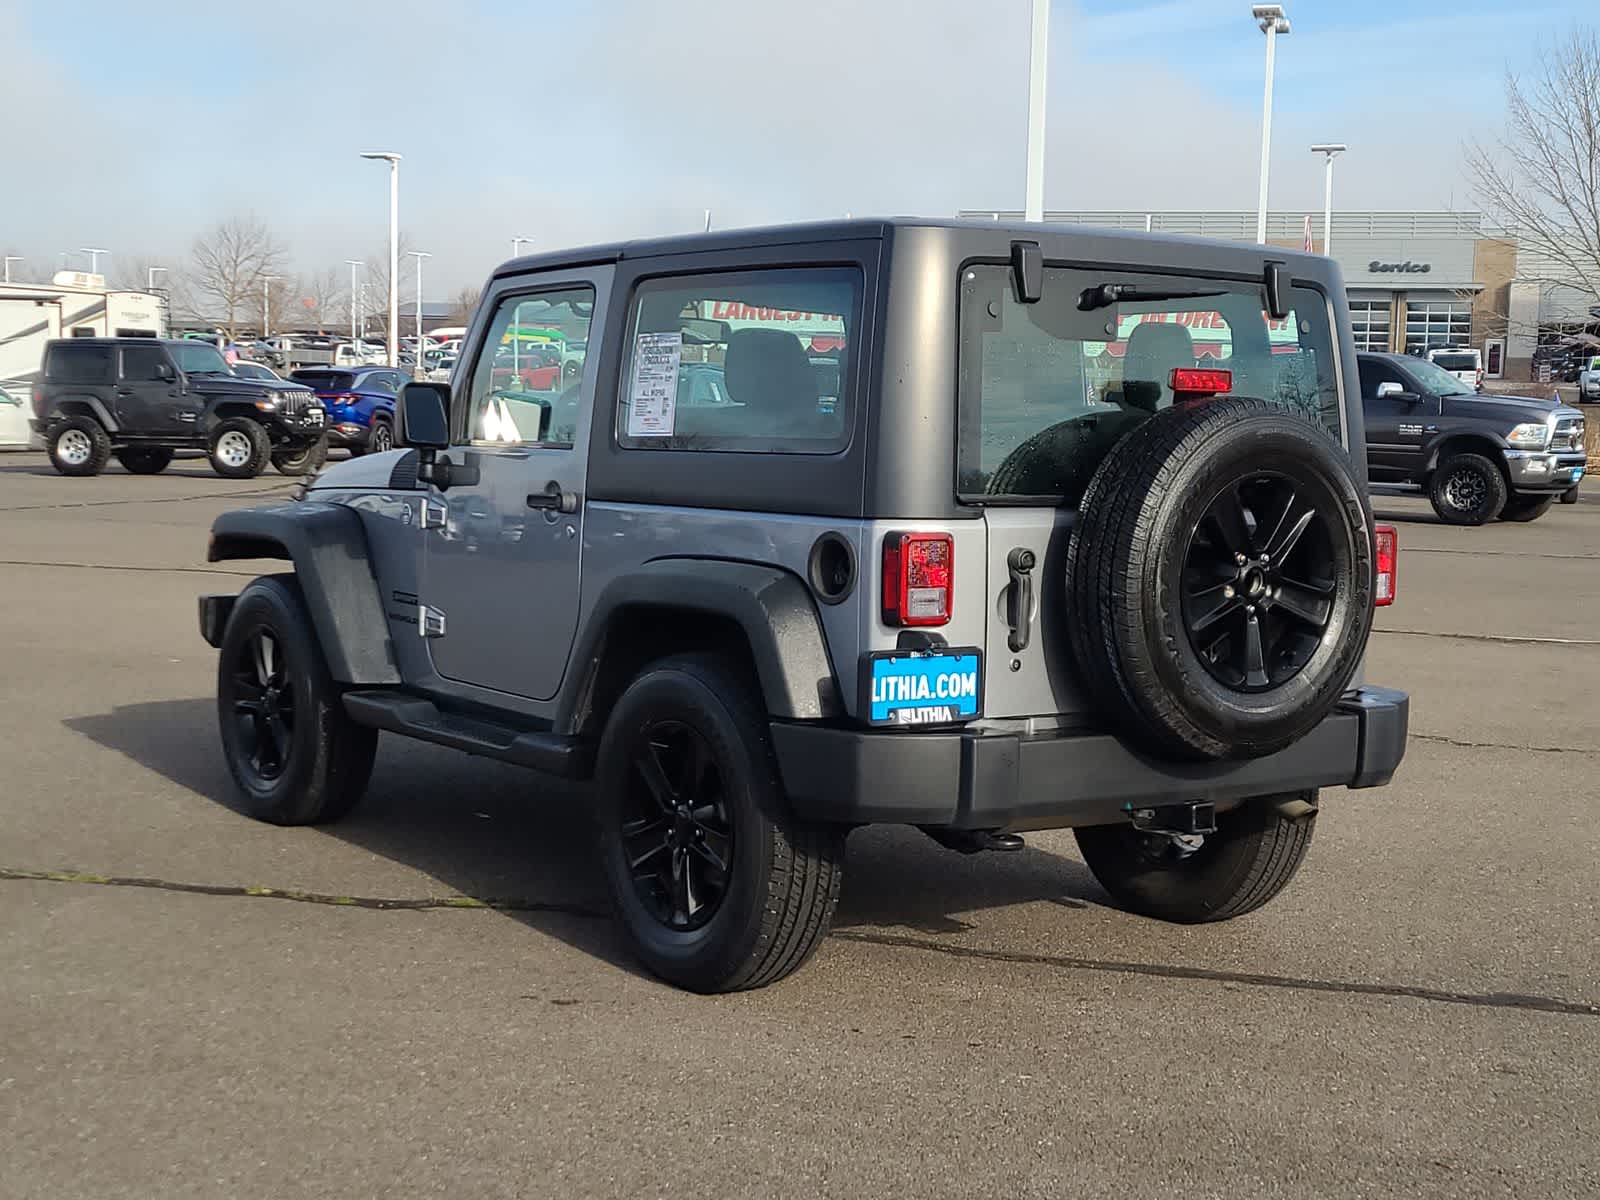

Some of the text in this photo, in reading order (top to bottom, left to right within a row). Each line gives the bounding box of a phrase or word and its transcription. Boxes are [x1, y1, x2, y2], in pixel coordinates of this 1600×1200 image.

[1368, 260, 1431, 273] Service
[872, 672, 976, 702] LITHIA.COM
[912, 706, 952, 723] LITHIA
